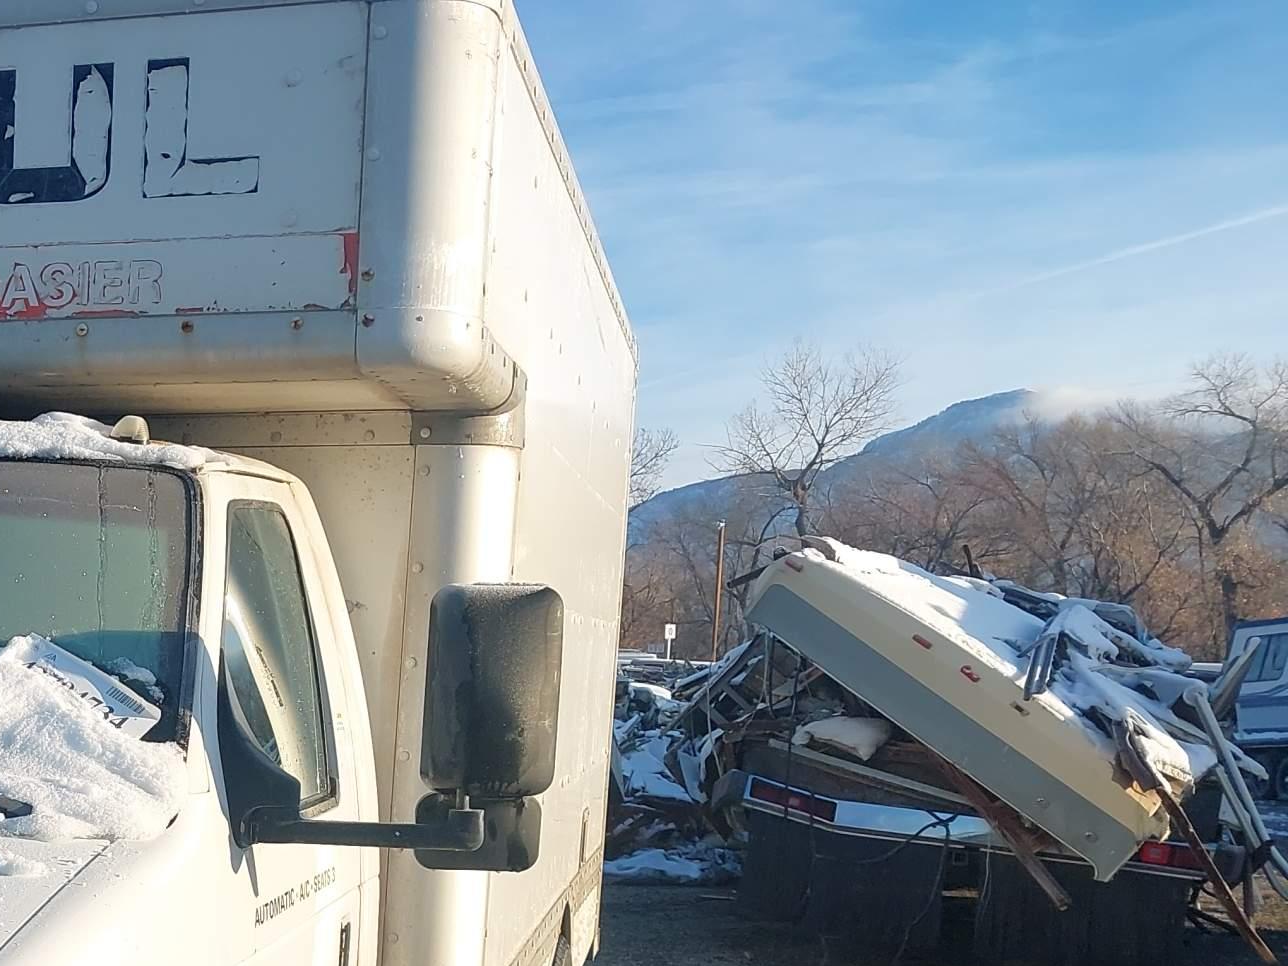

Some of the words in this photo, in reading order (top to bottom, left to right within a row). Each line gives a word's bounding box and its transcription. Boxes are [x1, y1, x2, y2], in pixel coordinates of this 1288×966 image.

[254, 887, 295, 928] AUTOMATIC
[299, 879, 310, 902] A/C
[313, 867, 331, 893] SEATS
